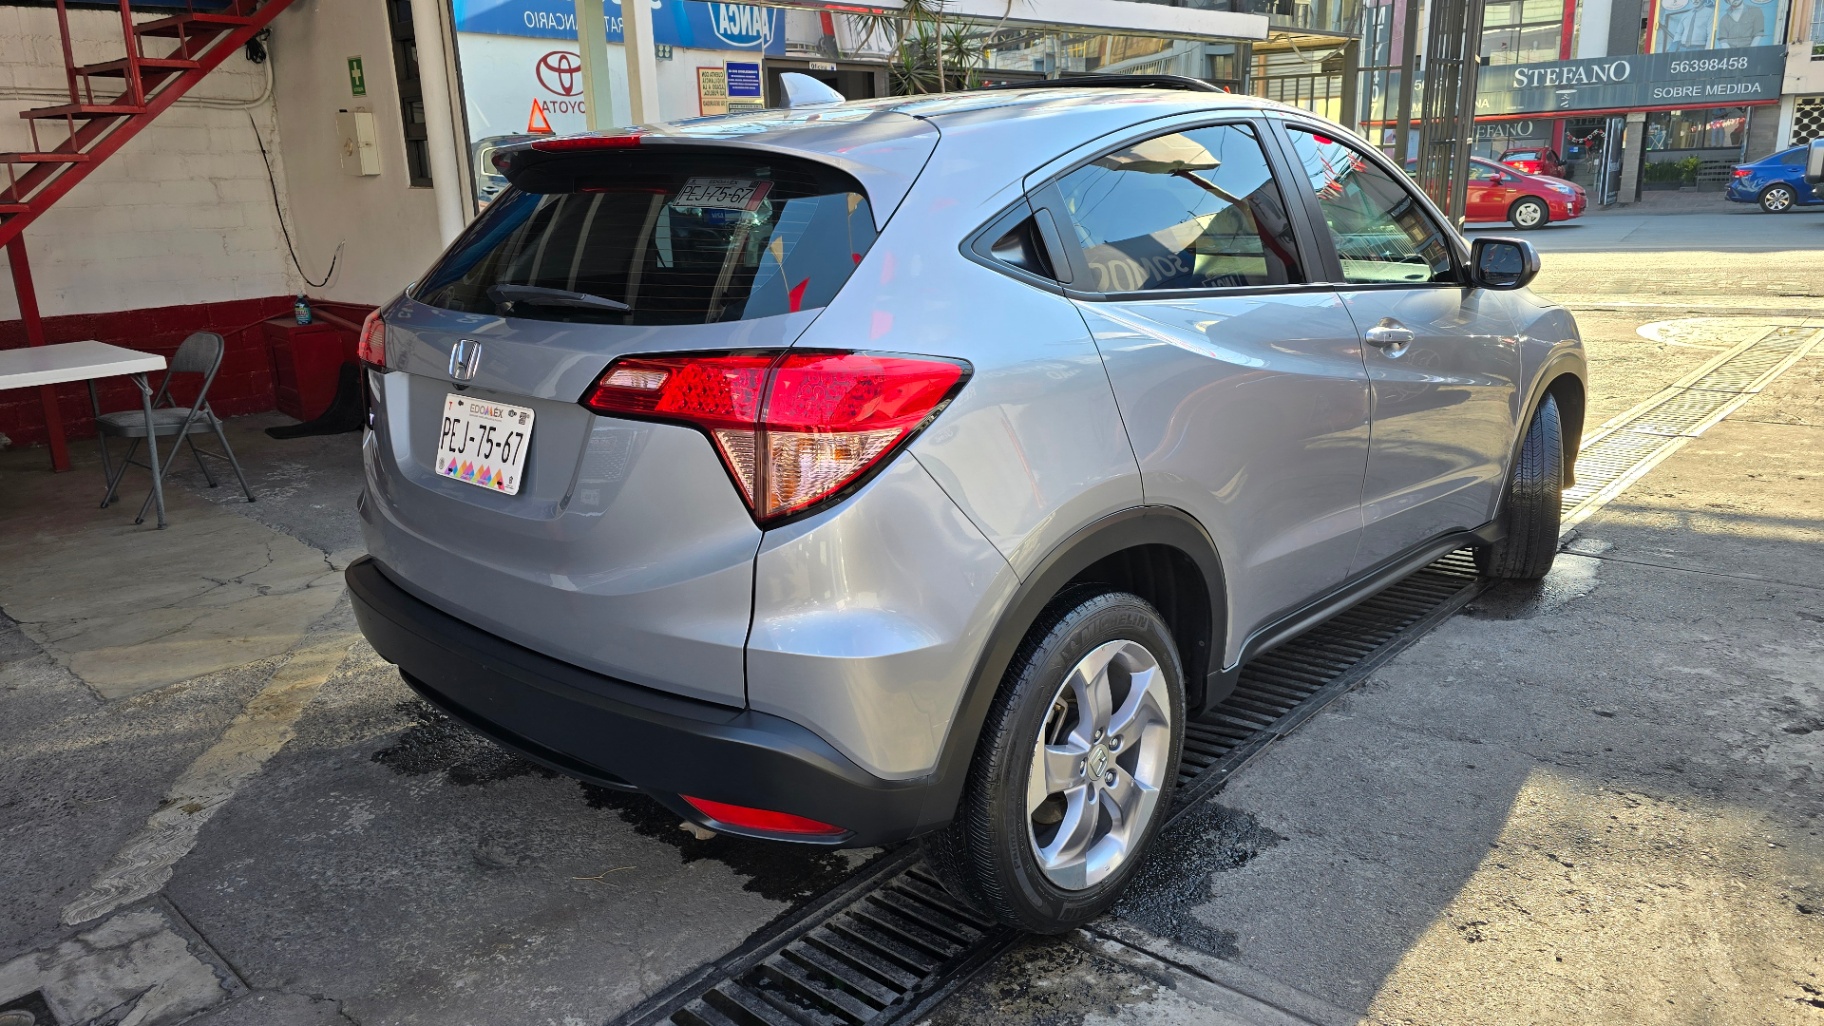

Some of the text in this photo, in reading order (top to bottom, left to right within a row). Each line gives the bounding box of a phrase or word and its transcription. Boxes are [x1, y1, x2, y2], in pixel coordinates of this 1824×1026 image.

[1669, 56, 1749, 74] 56398458
[1513, 59, 1631, 90] STEFANO
[1653, 81, 1762, 99] SOBRE MEDIDA
[1473, 120, 1533, 137] EFANO
[679, 185, 754, 203] PEJ-75-67
[440, 416, 524, 466] PEJ-75-67
